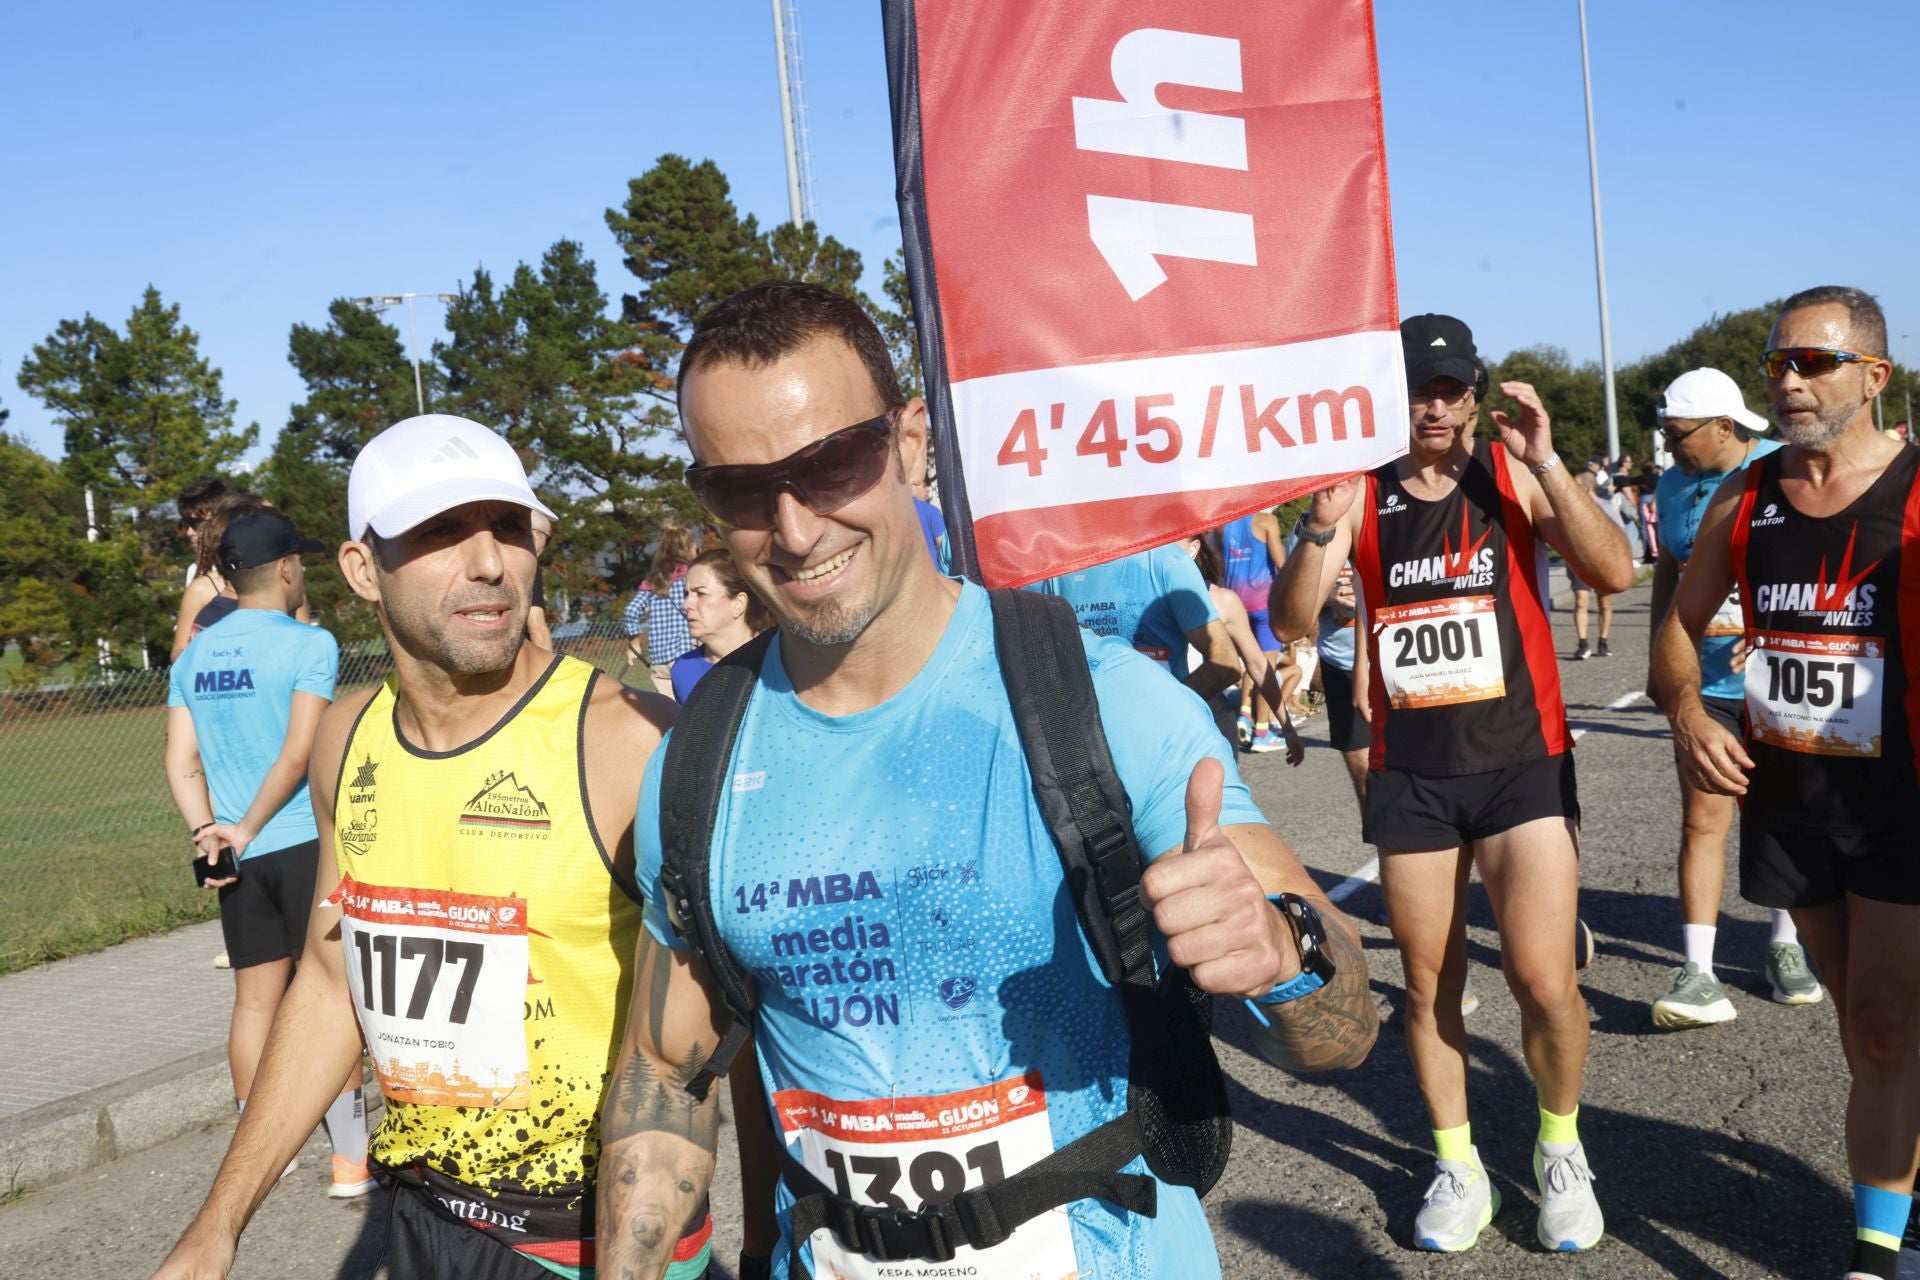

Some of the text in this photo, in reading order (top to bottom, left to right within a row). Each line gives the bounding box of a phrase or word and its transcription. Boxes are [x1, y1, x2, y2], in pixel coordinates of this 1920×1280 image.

[1072, 28, 1258, 302] 1h
[1378, 504, 1407, 516] VIATOR
[1751, 516, 1785, 527] VIATOR
[1090, 602, 1116, 611] MBA
[1085, 615, 1118, 626] media
[1394, 618, 1483, 668] 2001
[1782, 639, 1806, 648] MBA
[1828, 641, 1859, 651] GIJÓN
[194, 668, 255, 693] MBA
[1767, 656, 1855, 709] 1051
[473, 800, 540, 817] AltoNalón
[459, 828, 548, 840] CLUB DEPORTIVO
[786, 871, 884, 908] MBA
[371, 899, 415, 915] MBA
[448, 905, 491, 923] GIJÓN
[771, 915, 890, 957] media
[354, 930, 484, 1025] 1177
[793, 986, 900, 1029] IJÓN
[377, 1031, 455, 1050] JONATAN TOBIO
[895, 1111, 925, 1121] media
[938, 1099, 999, 1127] GIJÓN
[840, 1114, 893, 1132] MBA
[896, 1118, 938, 1130] maratón
[951, 1121, 984, 1132] OCTUBRE
[916, 1266, 978, 1278] MORENO
